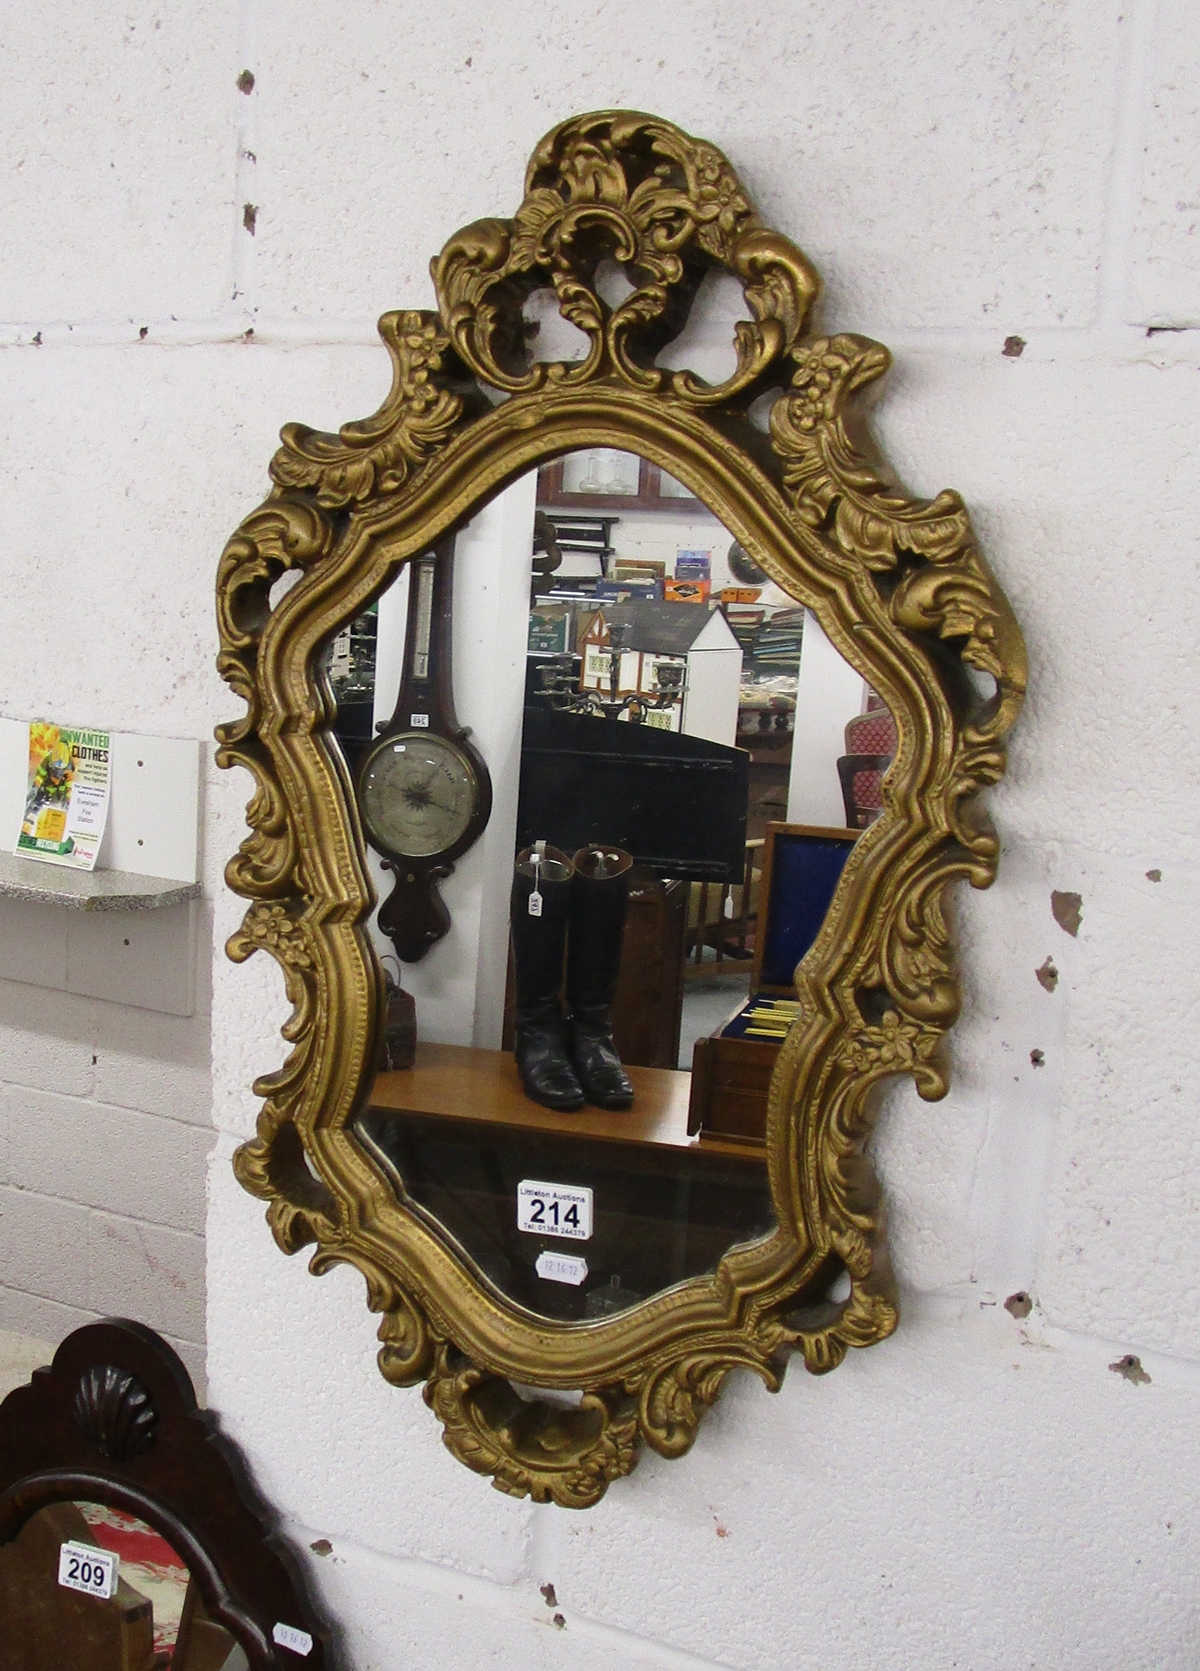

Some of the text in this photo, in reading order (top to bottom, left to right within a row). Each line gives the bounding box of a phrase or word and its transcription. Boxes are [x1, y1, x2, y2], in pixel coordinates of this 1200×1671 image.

[72, 745, 108, 763] CLOTHES
[520, 1188, 585, 1203] Littleton Auctions
[530, 1199, 580, 1228] 214
[68, 1558, 104, 1586] 209
